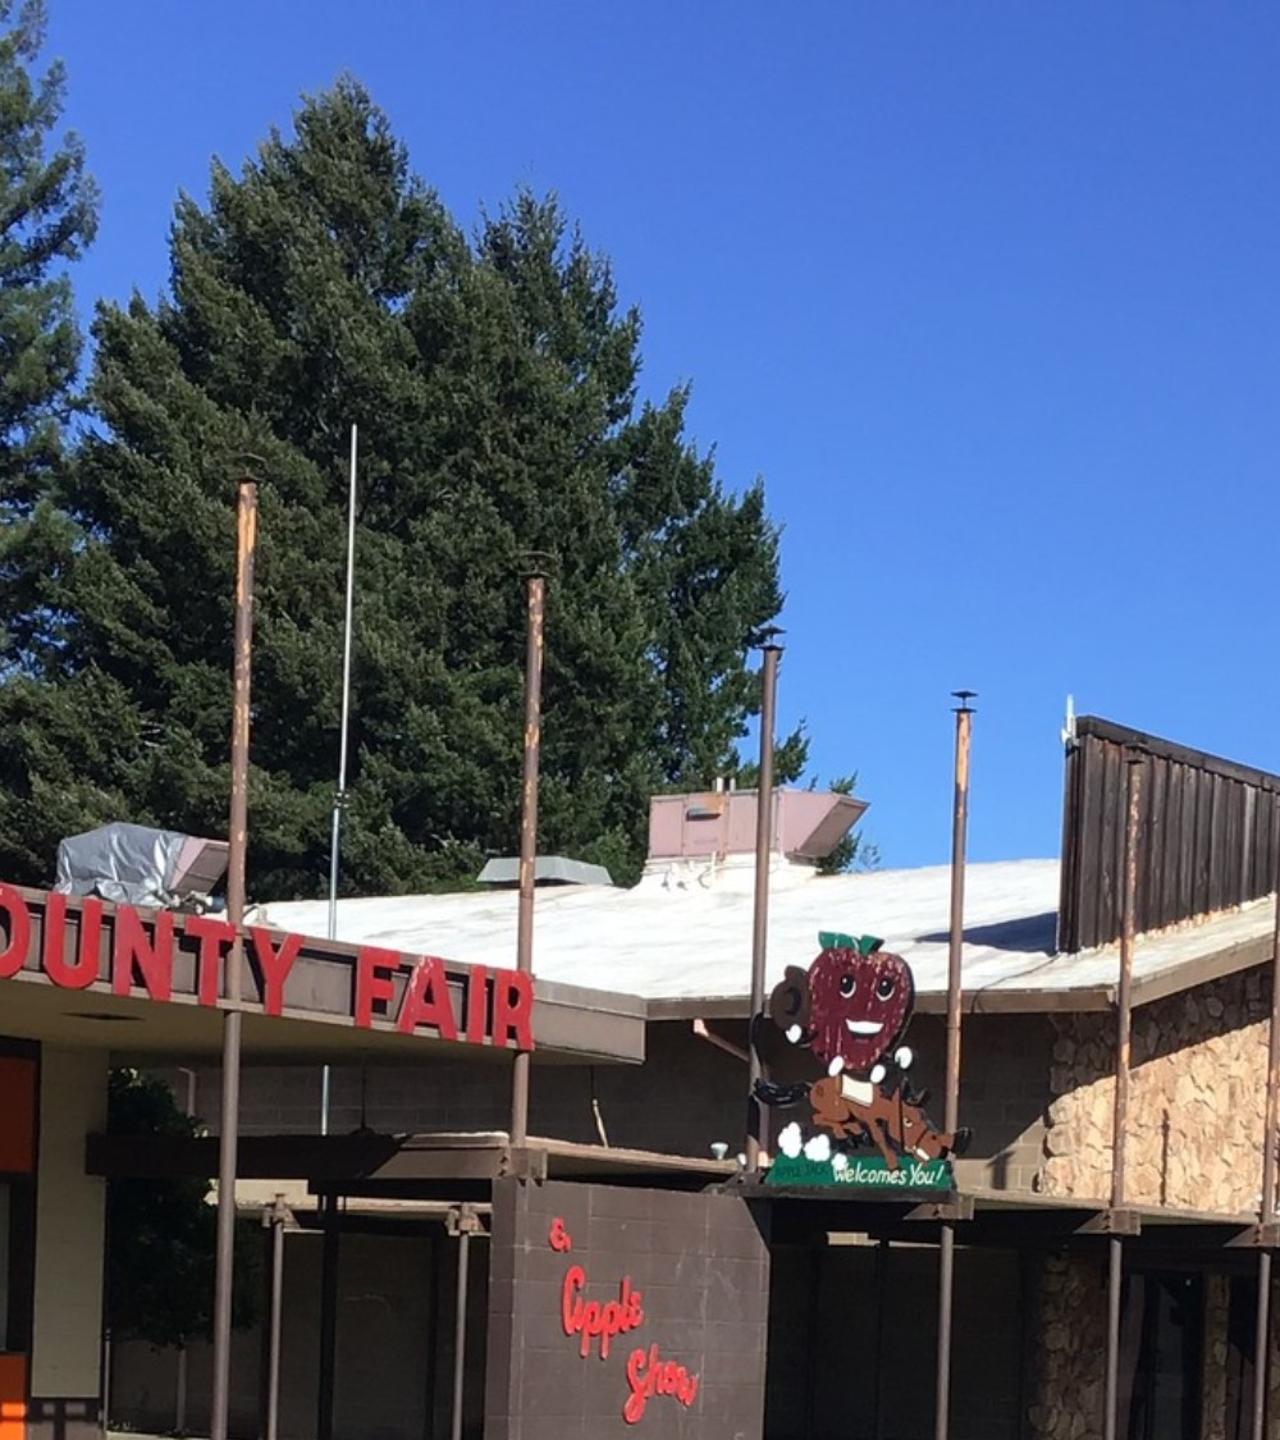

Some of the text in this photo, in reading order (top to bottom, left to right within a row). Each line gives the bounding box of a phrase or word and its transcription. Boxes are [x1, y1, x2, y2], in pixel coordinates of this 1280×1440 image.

[353, 946, 535, 1052] FAIR
[832, 1161, 908, 1186] Welcomes
[909, 1162, 945, 1187] You!
[562, 1265, 644, 1360] Apple
[623, 1343, 697, 1424] Show
